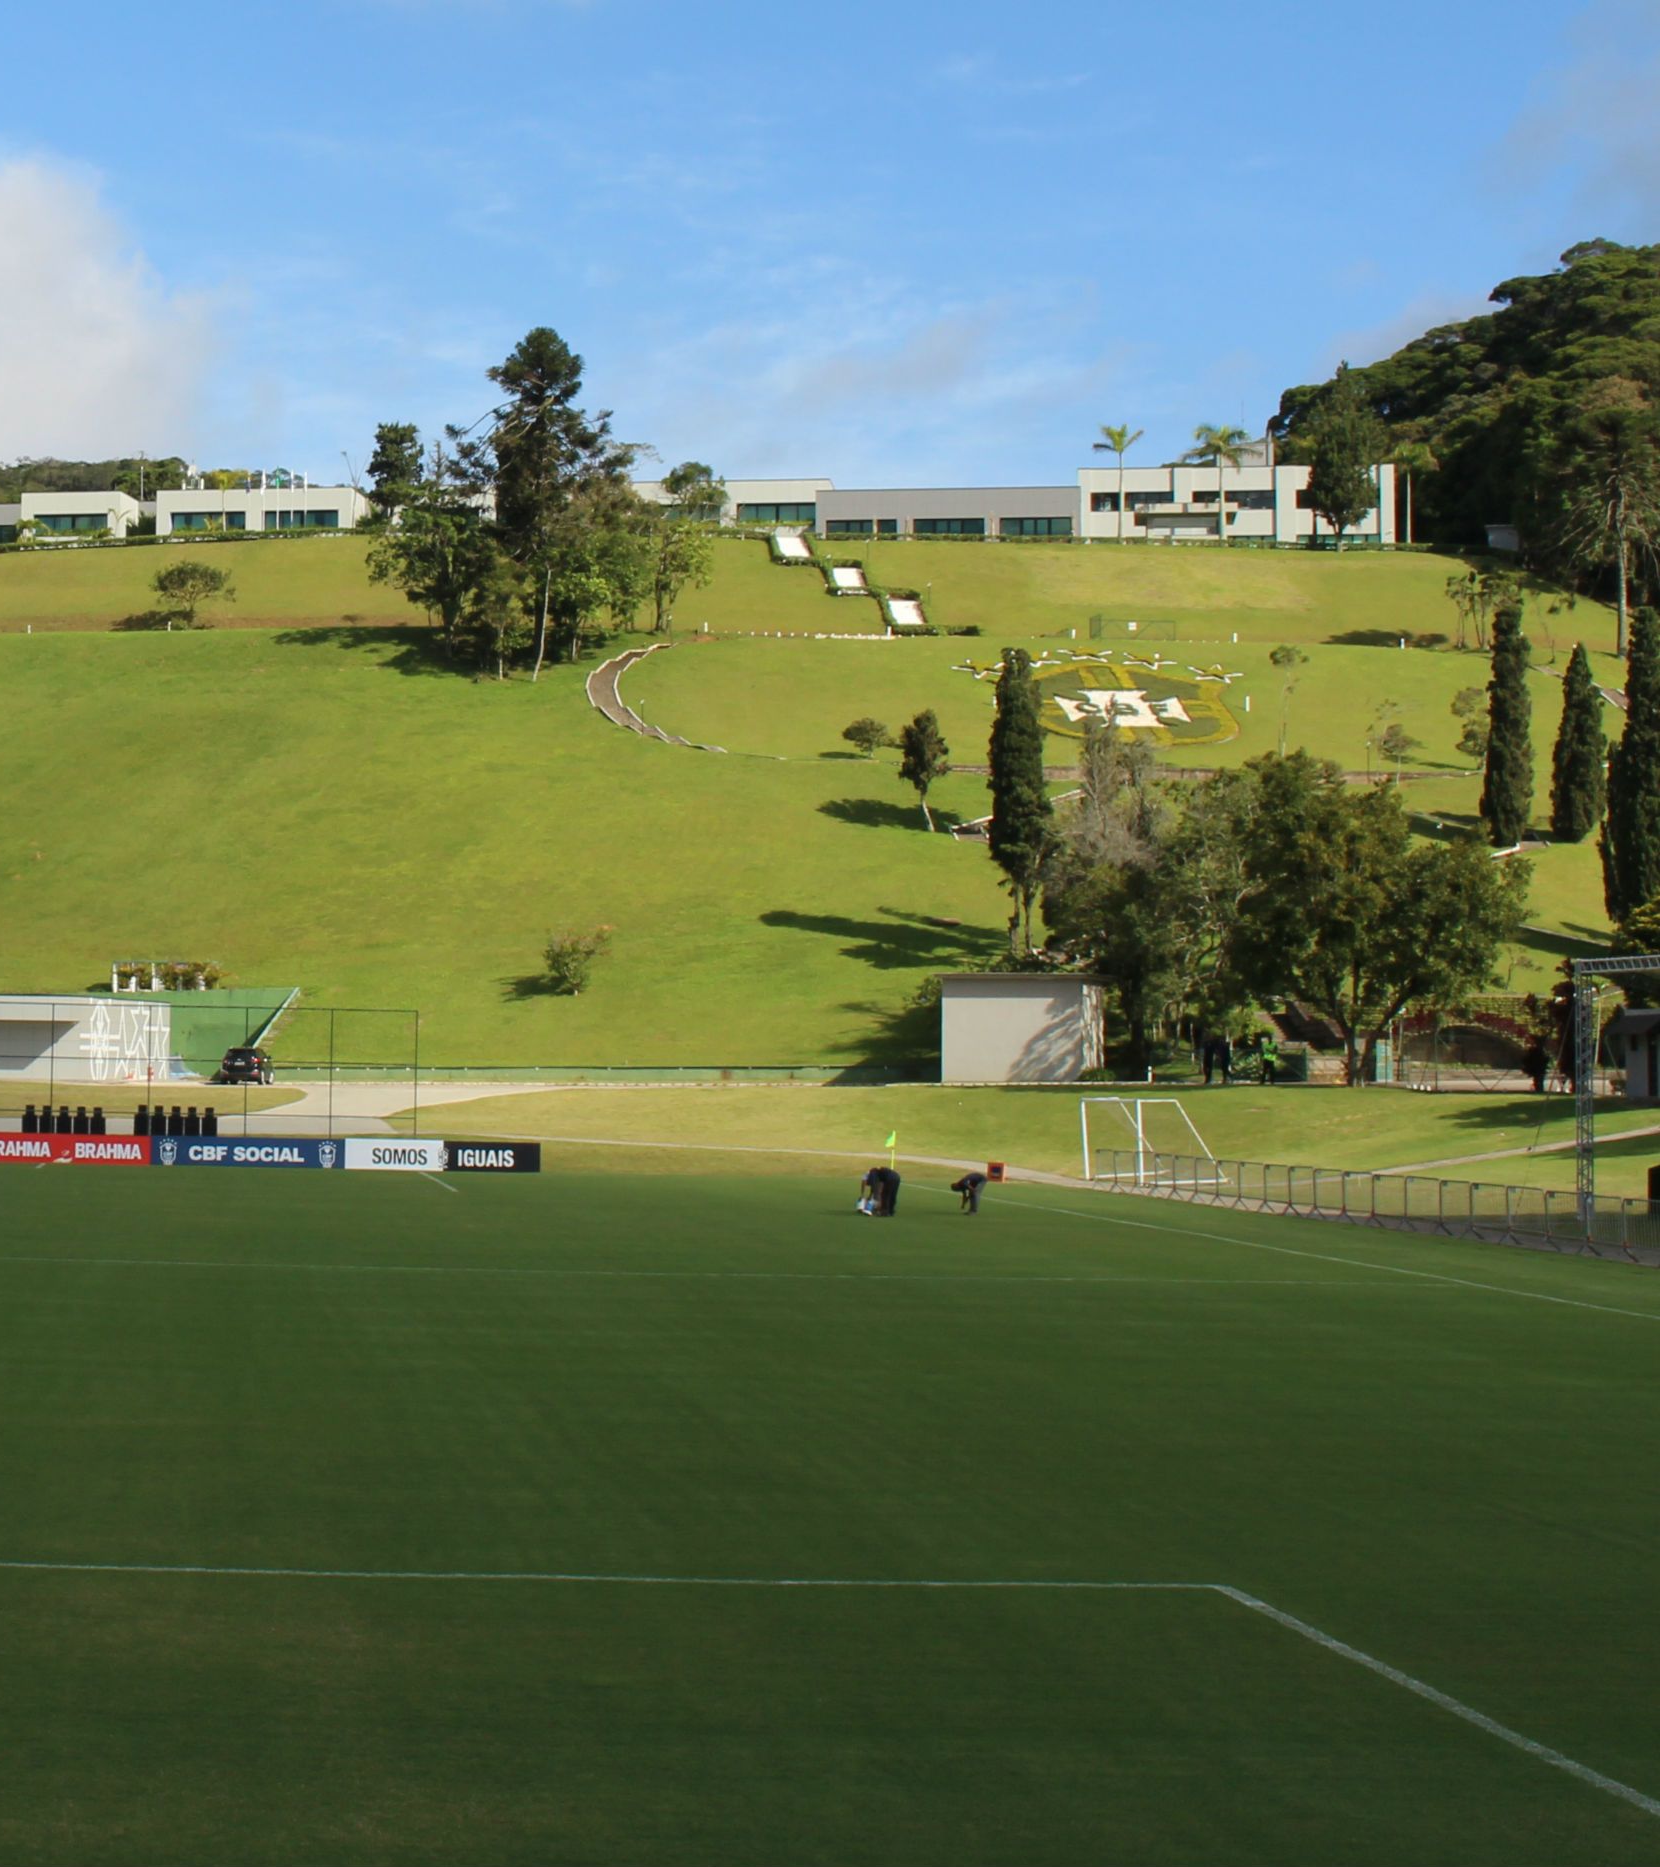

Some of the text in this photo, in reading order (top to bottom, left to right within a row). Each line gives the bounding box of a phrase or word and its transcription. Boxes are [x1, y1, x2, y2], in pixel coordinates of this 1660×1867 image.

[1074, 702, 1169, 717] CBF
[75, 1142, 142, 1160] BRAHMA
[189, 1145, 228, 1161] CBF
[233, 1147, 305, 1163] SOCIAL
[372, 1147, 428, 1165] SOMOS
[457, 1149, 515, 1168] IGUAIS
